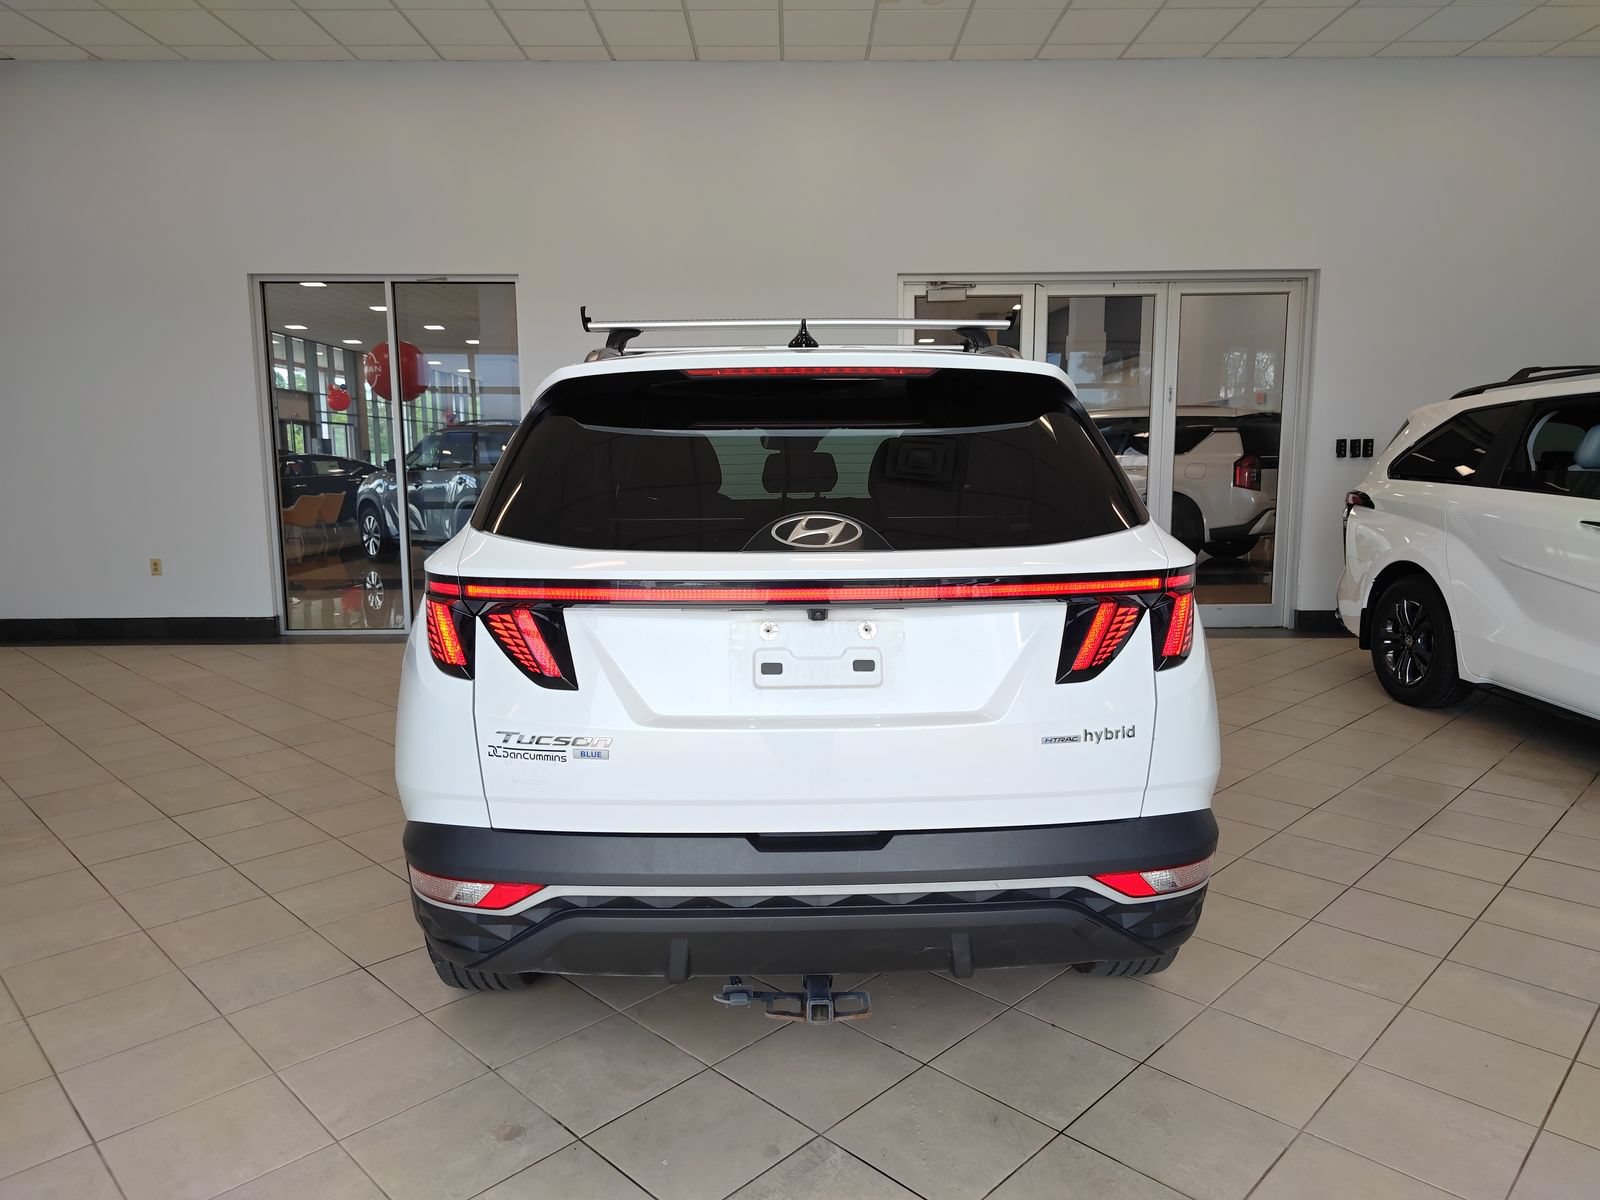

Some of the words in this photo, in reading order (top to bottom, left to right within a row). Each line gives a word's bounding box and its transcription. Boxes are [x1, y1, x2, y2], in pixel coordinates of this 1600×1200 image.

[1044, 736, 1079, 744] HTRAC
[1083, 725, 1135, 744] hybrid
[580, 750, 603, 759] BLUE
